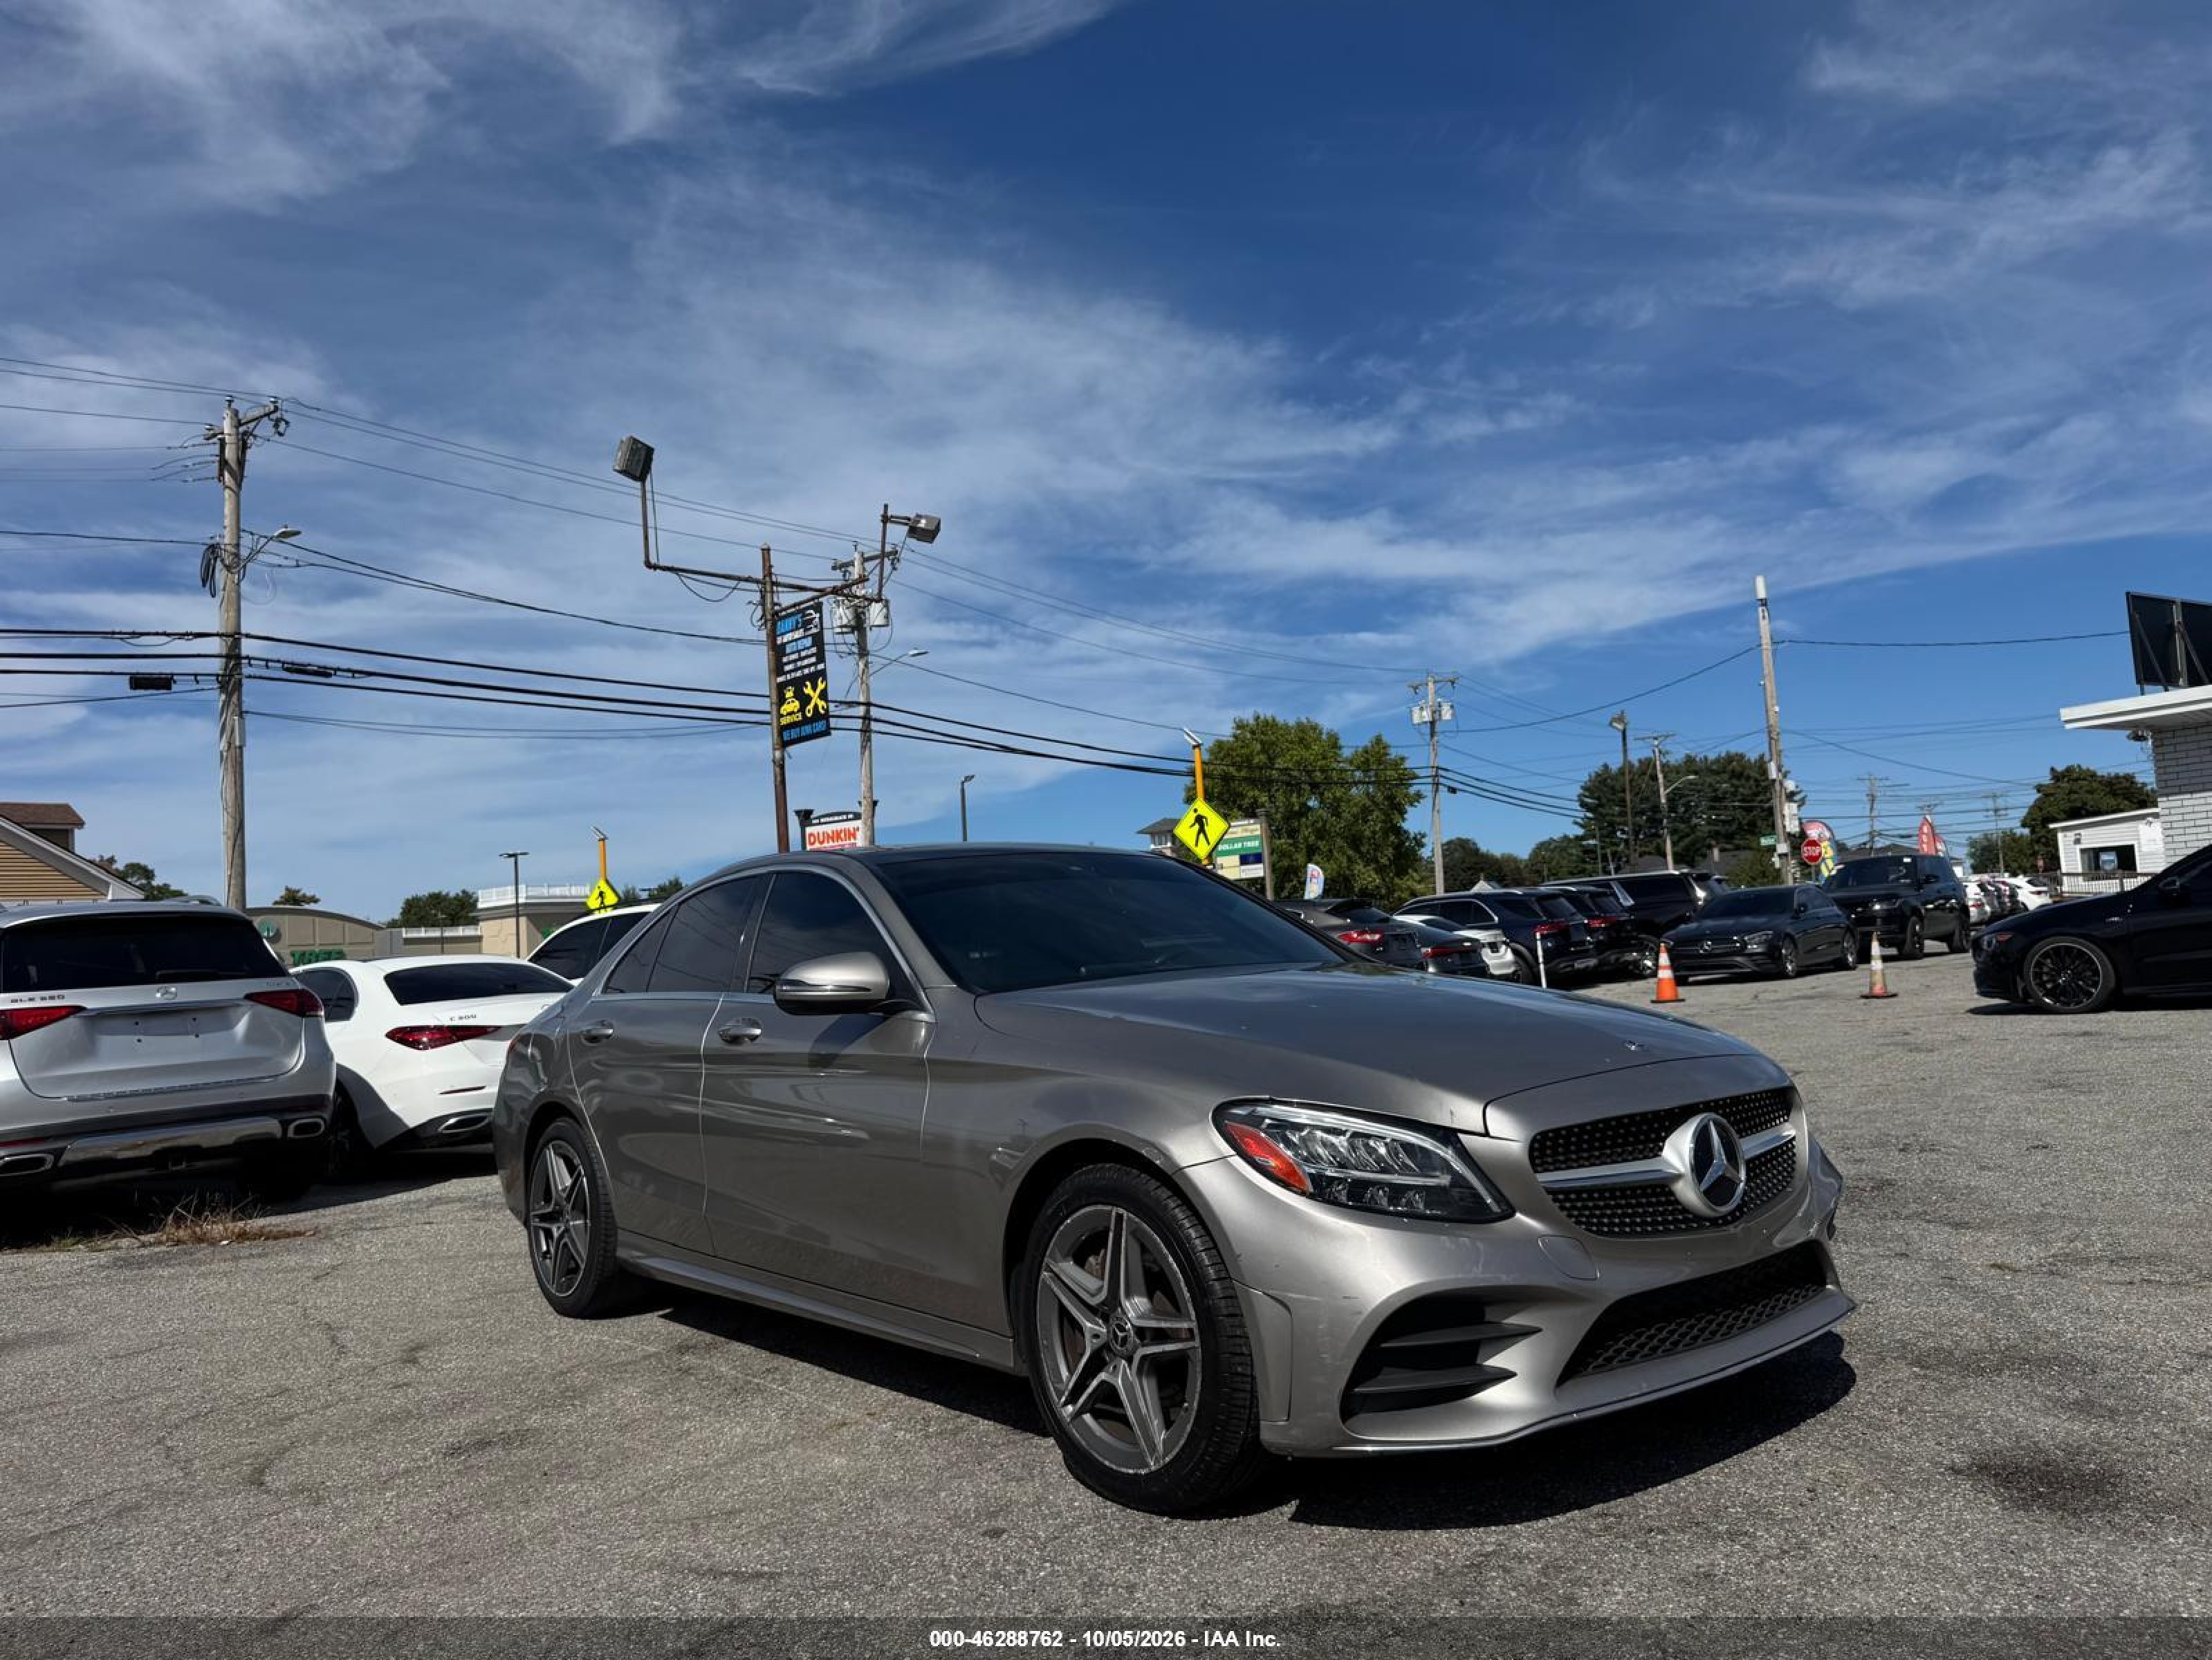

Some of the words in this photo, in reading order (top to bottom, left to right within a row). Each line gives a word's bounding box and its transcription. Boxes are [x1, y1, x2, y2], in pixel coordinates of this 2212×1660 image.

[780, 712, 802, 726] SERVICE
[807, 826, 860, 846] DUNKIN'
[1218, 842, 1242, 851] DOLLAR
[1803, 846, 1821, 857] STOP
